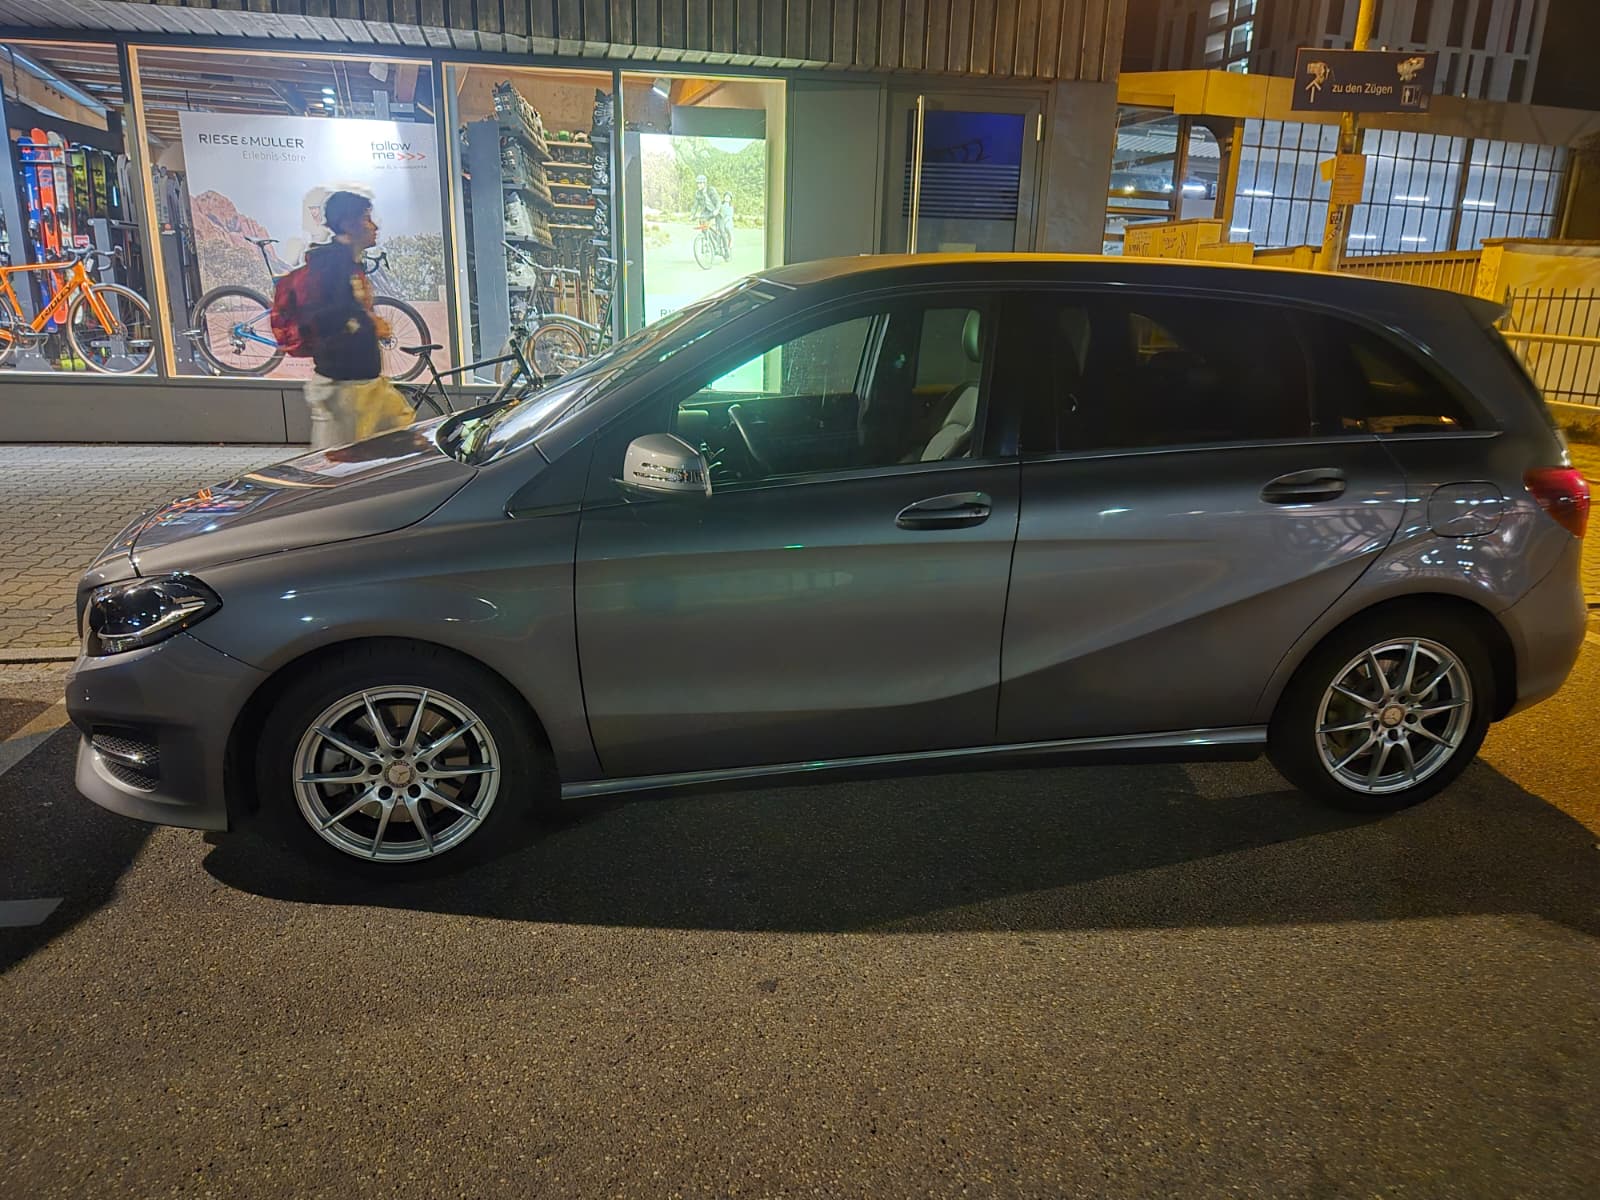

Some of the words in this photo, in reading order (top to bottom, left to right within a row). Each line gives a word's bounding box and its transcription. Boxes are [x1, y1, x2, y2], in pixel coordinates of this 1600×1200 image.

[1332, 84, 1343, 93] zu
[1345, 83, 1362, 94] den
[1364, 82, 1393, 96] Zügen
[199, 133, 239, 145] RIESE
[249, 136, 305, 149] MÜLLER
[371, 140, 411, 151] follow
[372, 152, 395, 160] me
